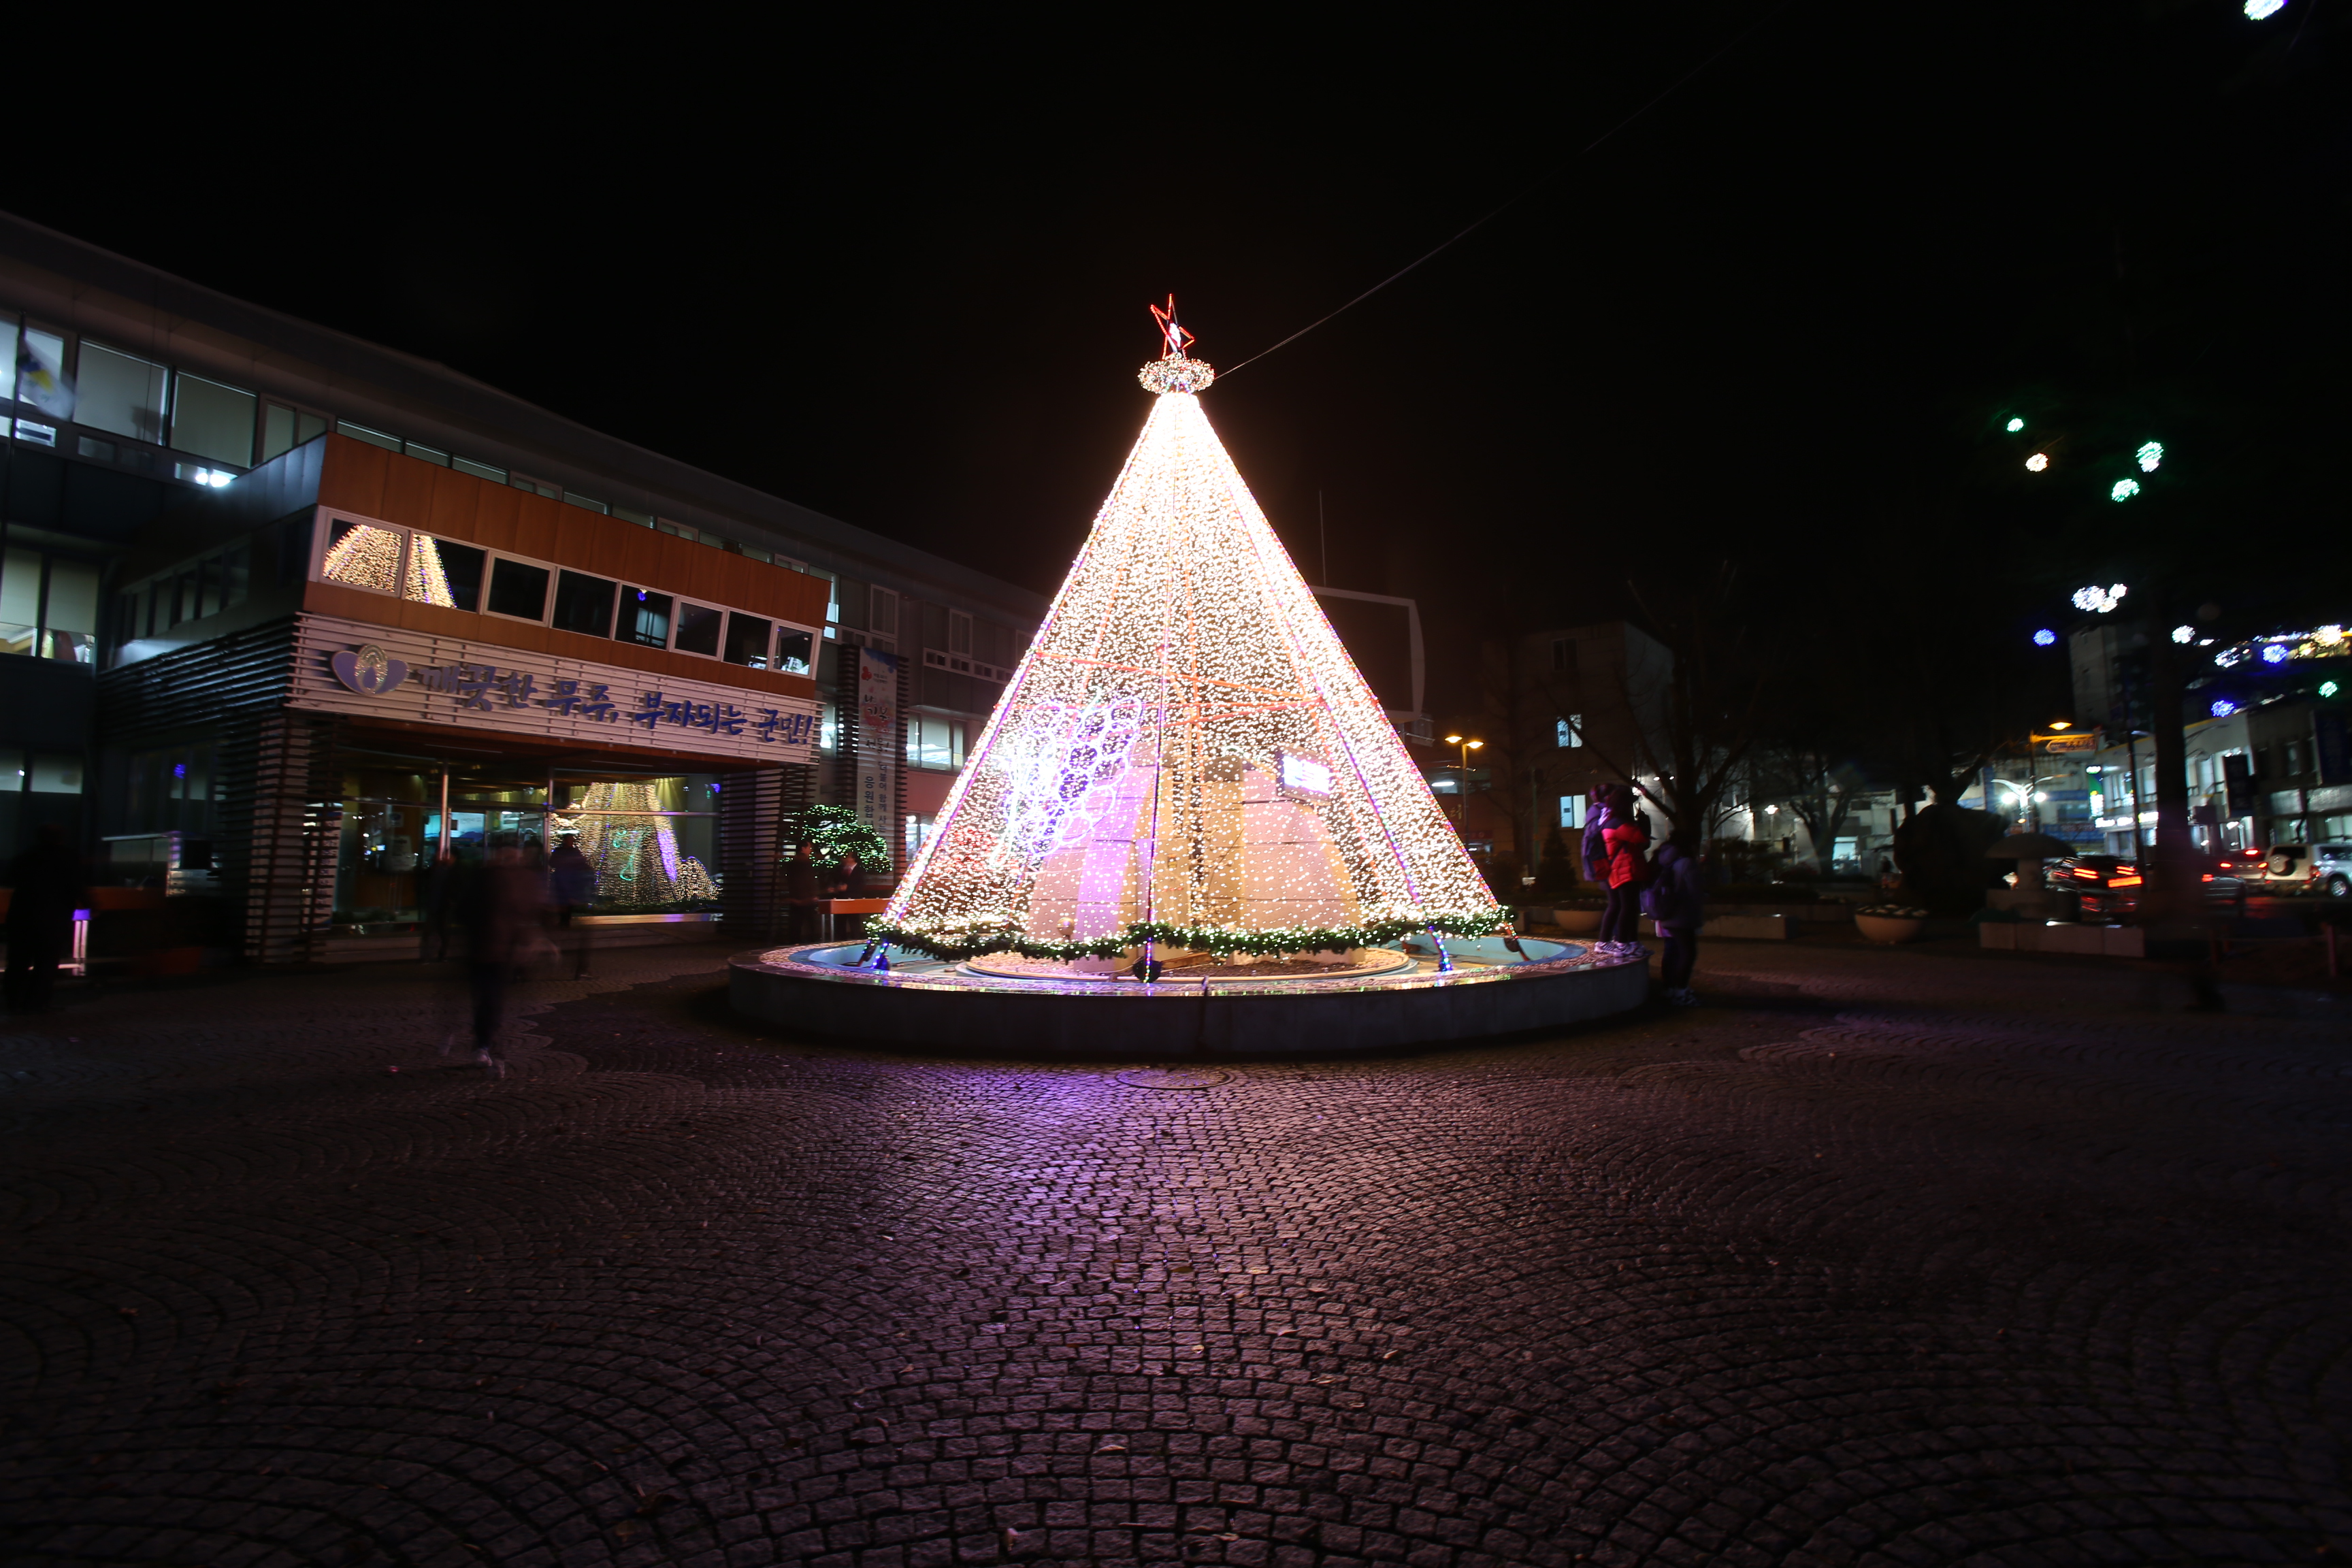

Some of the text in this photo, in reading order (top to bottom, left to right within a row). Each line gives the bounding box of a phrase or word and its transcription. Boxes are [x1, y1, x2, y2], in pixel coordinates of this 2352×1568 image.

[418, 666, 813, 745] 깨끗한 무주, 부자되는 군민!
